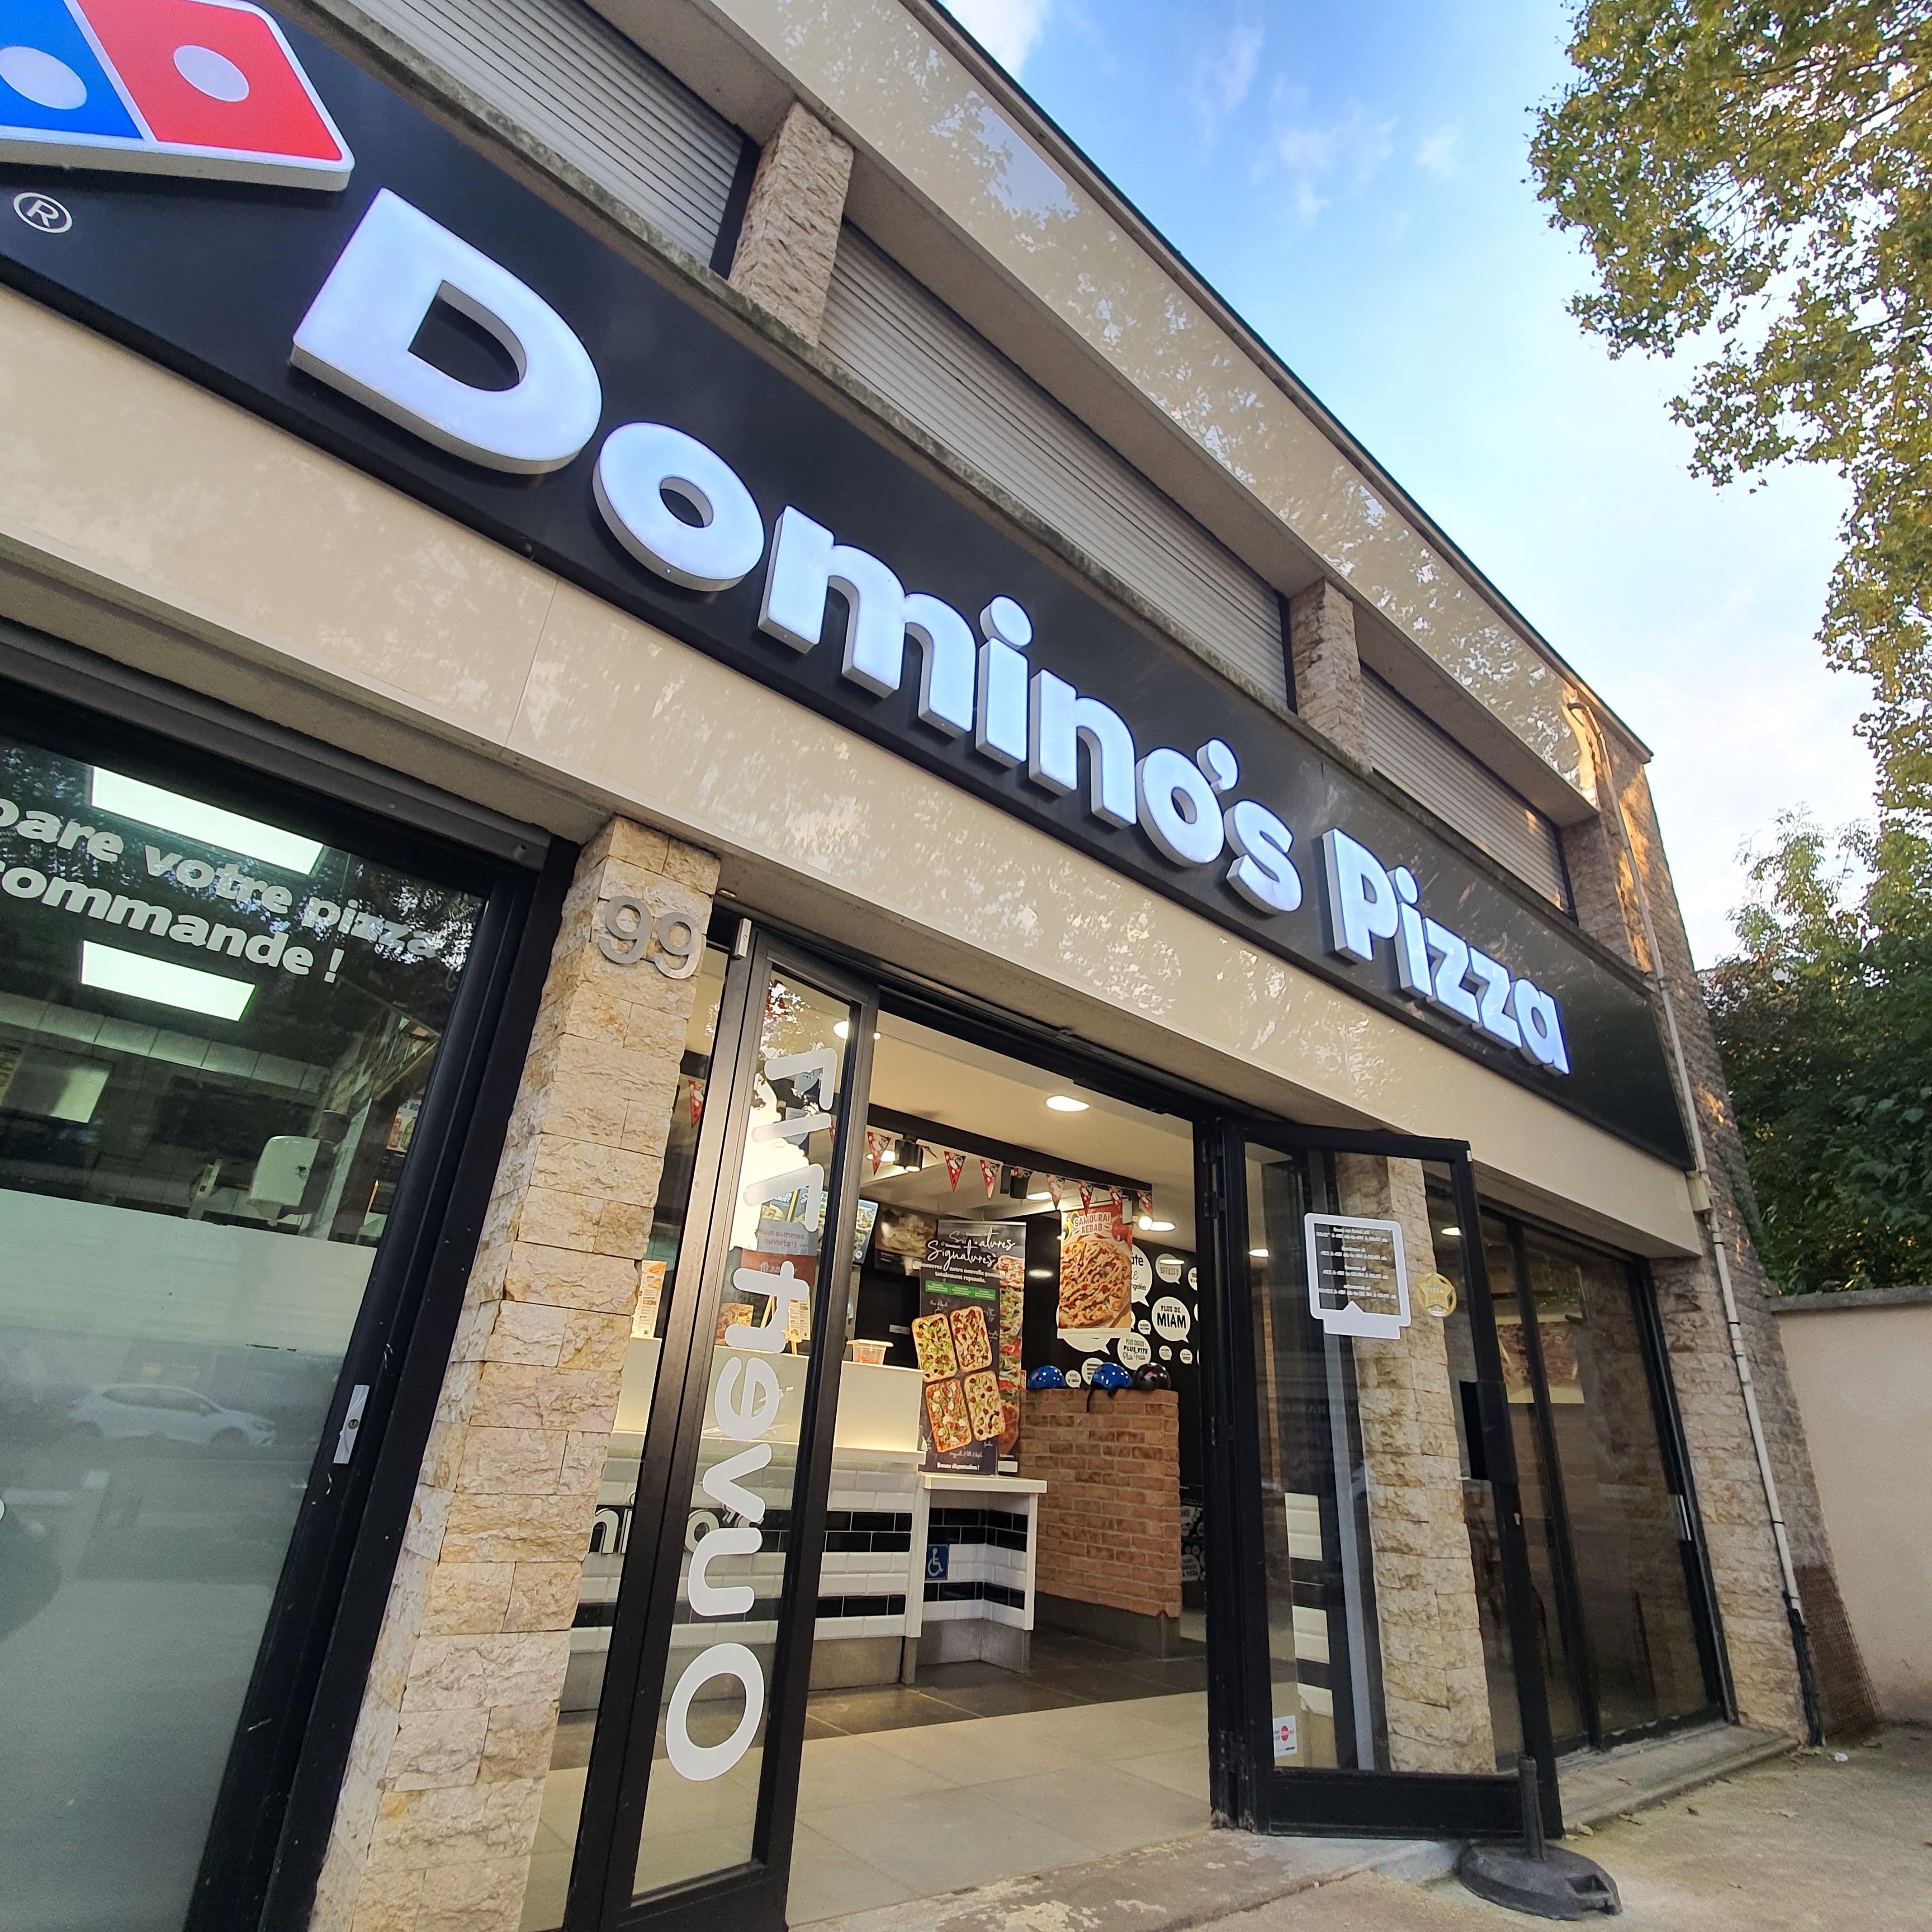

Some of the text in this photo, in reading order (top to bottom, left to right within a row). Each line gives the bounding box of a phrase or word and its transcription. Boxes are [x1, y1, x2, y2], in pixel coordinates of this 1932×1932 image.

[290, 187, 1570, 1074] Domino's Pizza
[145, 845, 292, 914] votre
[0, 860, 314, 975] ommande
[599, 896, 702, 979] 99
[1074, 1214, 1110, 1227] SAMOURAI
[1082, 1223, 1102, 1234] KEBAB
[927, 1237, 996, 1271] Signatures
[1157, 1313, 1186, 1329] MIAM
